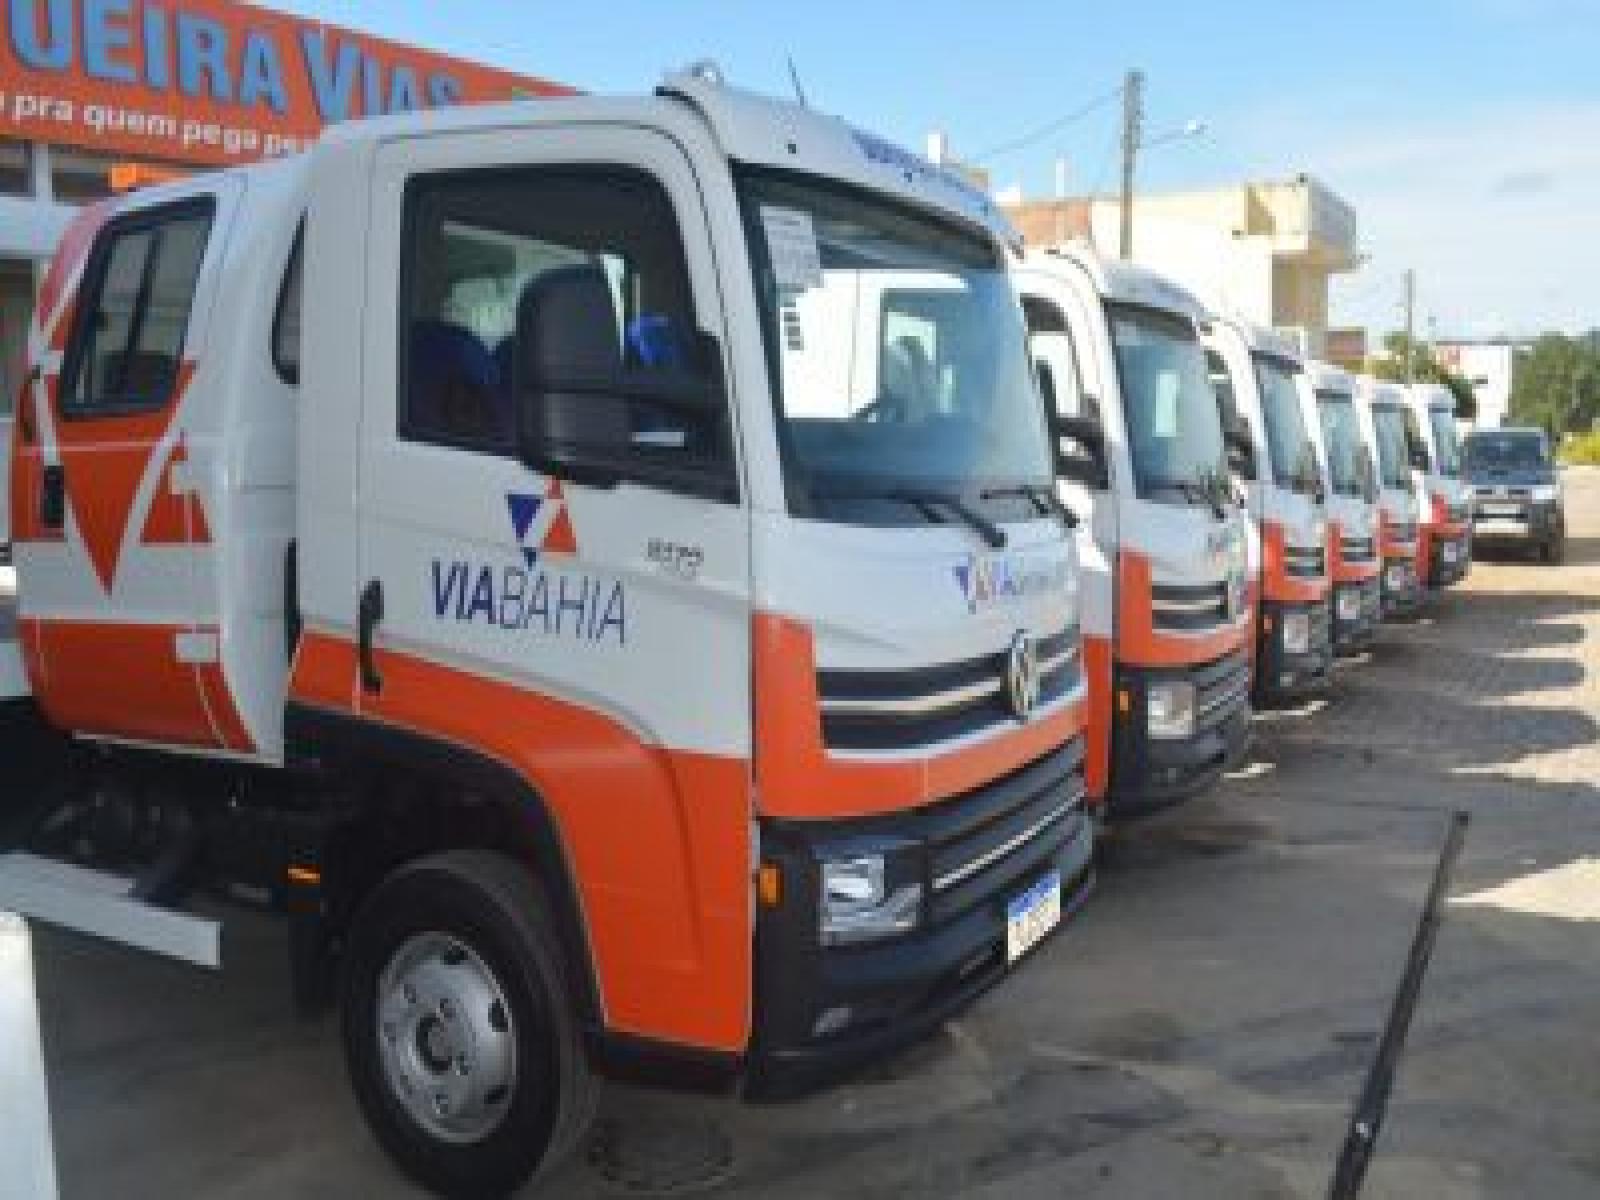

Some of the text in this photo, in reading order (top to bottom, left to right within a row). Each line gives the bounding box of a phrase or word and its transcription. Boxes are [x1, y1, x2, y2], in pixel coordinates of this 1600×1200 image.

[12, 95, 73, 124] pra
[82, 104, 177, 135] quem
[430, 559, 625, 648] VIABAHIA
